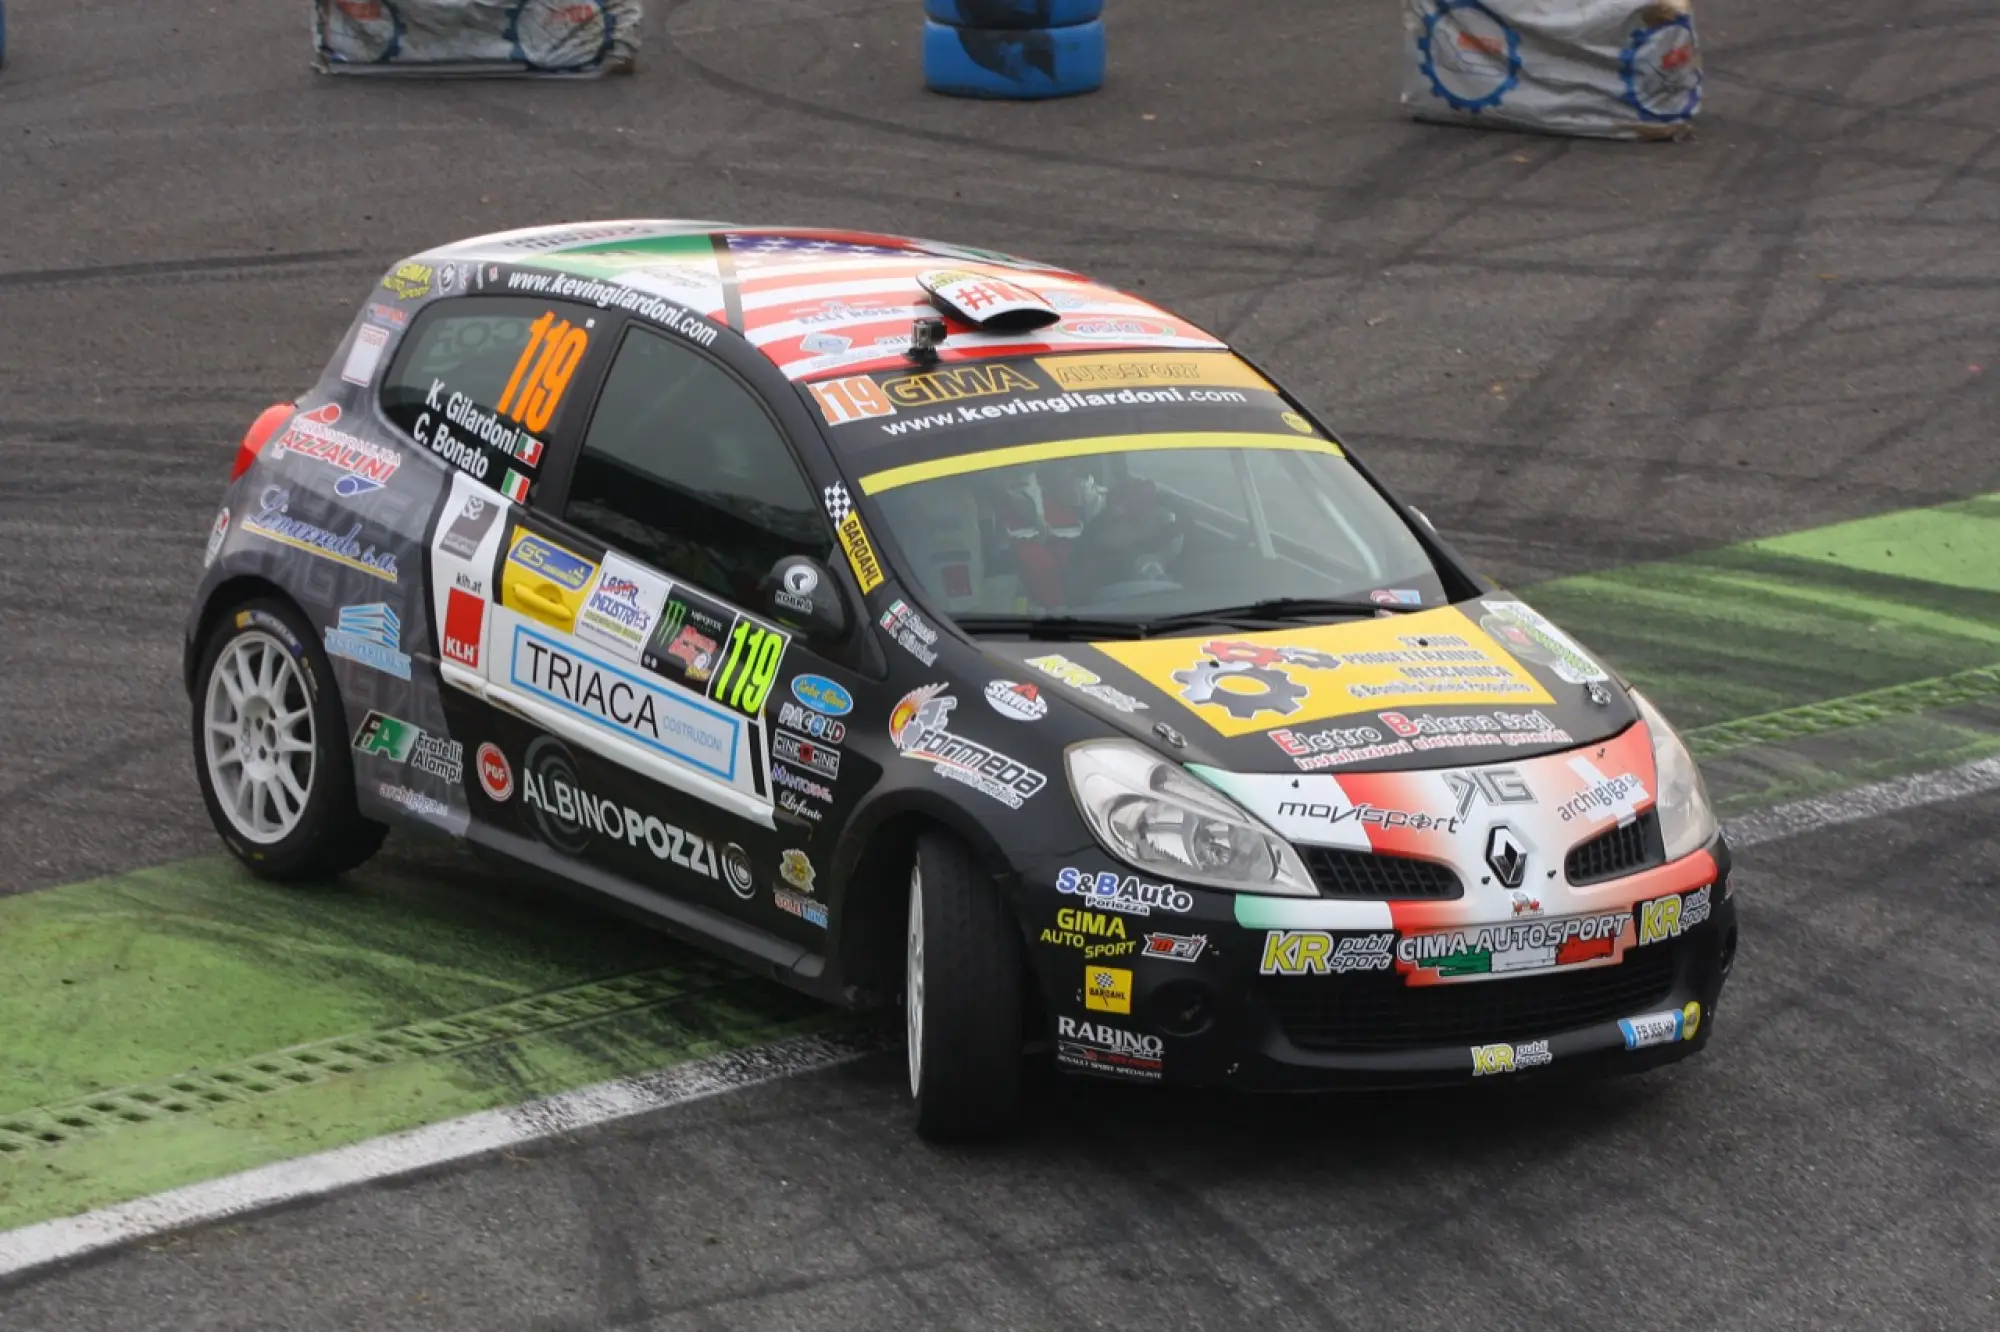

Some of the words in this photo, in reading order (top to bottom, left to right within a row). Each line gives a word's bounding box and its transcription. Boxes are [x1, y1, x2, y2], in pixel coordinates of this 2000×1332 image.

[508, 271, 718, 347] www.kevingilardoni.com
[498, 310, 589, 432] 119
[881, 364, 1040, 407] GIMA
[1056, 362, 1201, 384] AUTOSPORT
[425, 378, 444, 411] K.
[444, 389, 520, 455] Gilardoni
[882, 387, 1247, 436] www.kevingilardoni.com
[278, 430, 398, 485] AZZALINI
[413, 412, 430, 446] C.
[432, 418, 488, 479] Bonato
[843, 519, 880, 588] BARDAHL
[455, 571, 482, 595] klh.at
[446, 636, 475, 663] KLH
[714, 620, 783, 714] 119
[527, 641, 660, 739] TRIACA
[416, 729, 462, 762] Fratelli
[662, 715, 723, 753] COSTRUZIONI
[1268, 727, 1382, 757] Elettro
[411, 749, 463, 784] Alampi
[1277, 801, 1457, 834] movisport
[1557, 775, 1628, 822] archigiga
[1118, 875, 1193, 912] Auto
[1057, 907, 1126, 939] GIMA
[1398, 931, 1468, 961] GIMA
[1475, 912, 1633, 953] AUTOSPORT
[1639, 893, 1682, 947] KR
[1040, 928, 1085, 947] AUTO
[1084, 940, 1137, 959] SPORT
[1260, 930, 1333, 975] KR
[1336, 933, 1394, 953] publi
[1330, 953, 1392, 973] sport
[1088, 986, 1127, 1001] BARDAHL
[1058, 1015, 1164, 1051] RABINO
[1471, 1042, 1516, 1077] KR
